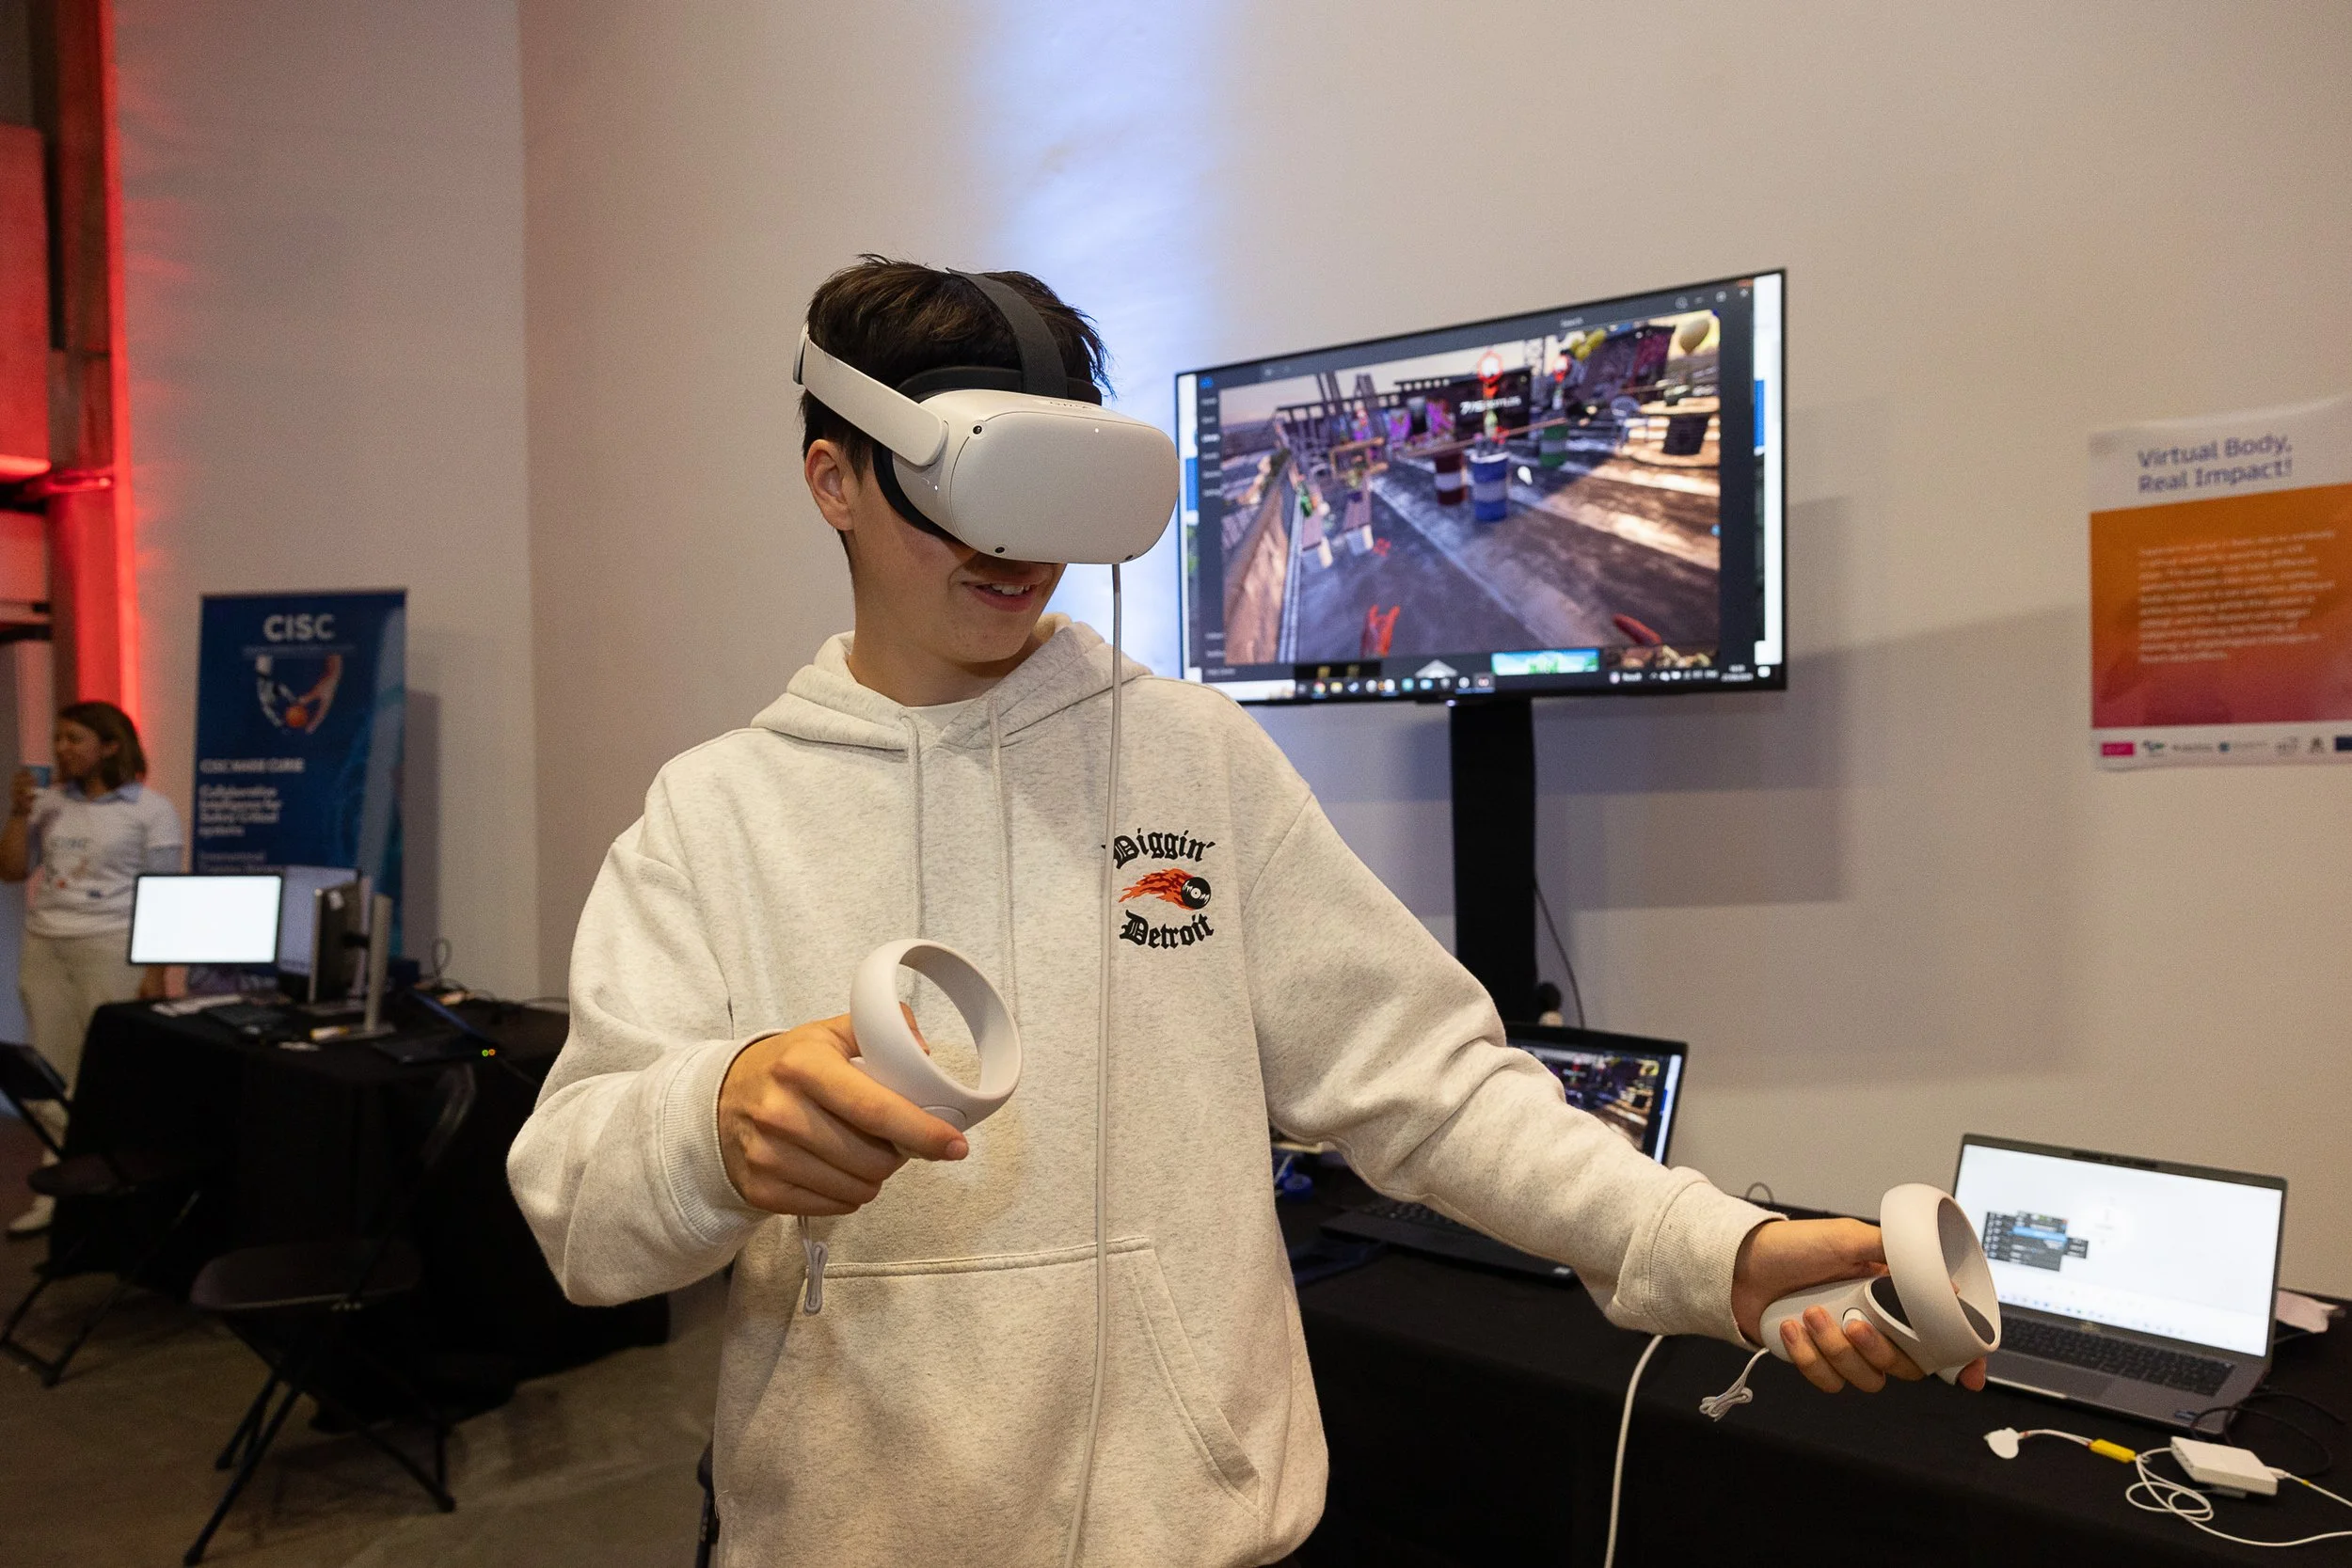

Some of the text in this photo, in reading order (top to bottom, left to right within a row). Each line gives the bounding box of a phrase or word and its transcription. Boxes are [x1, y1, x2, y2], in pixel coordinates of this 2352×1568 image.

[2137, 440, 2218, 467] Virtual
[2137, 458, 2293, 493] Real Impact!
[264, 612, 337, 641] CISC
[1102, 828, 1216, 869] Diggin'
[1120, 909, 1215, 949] Detroit
